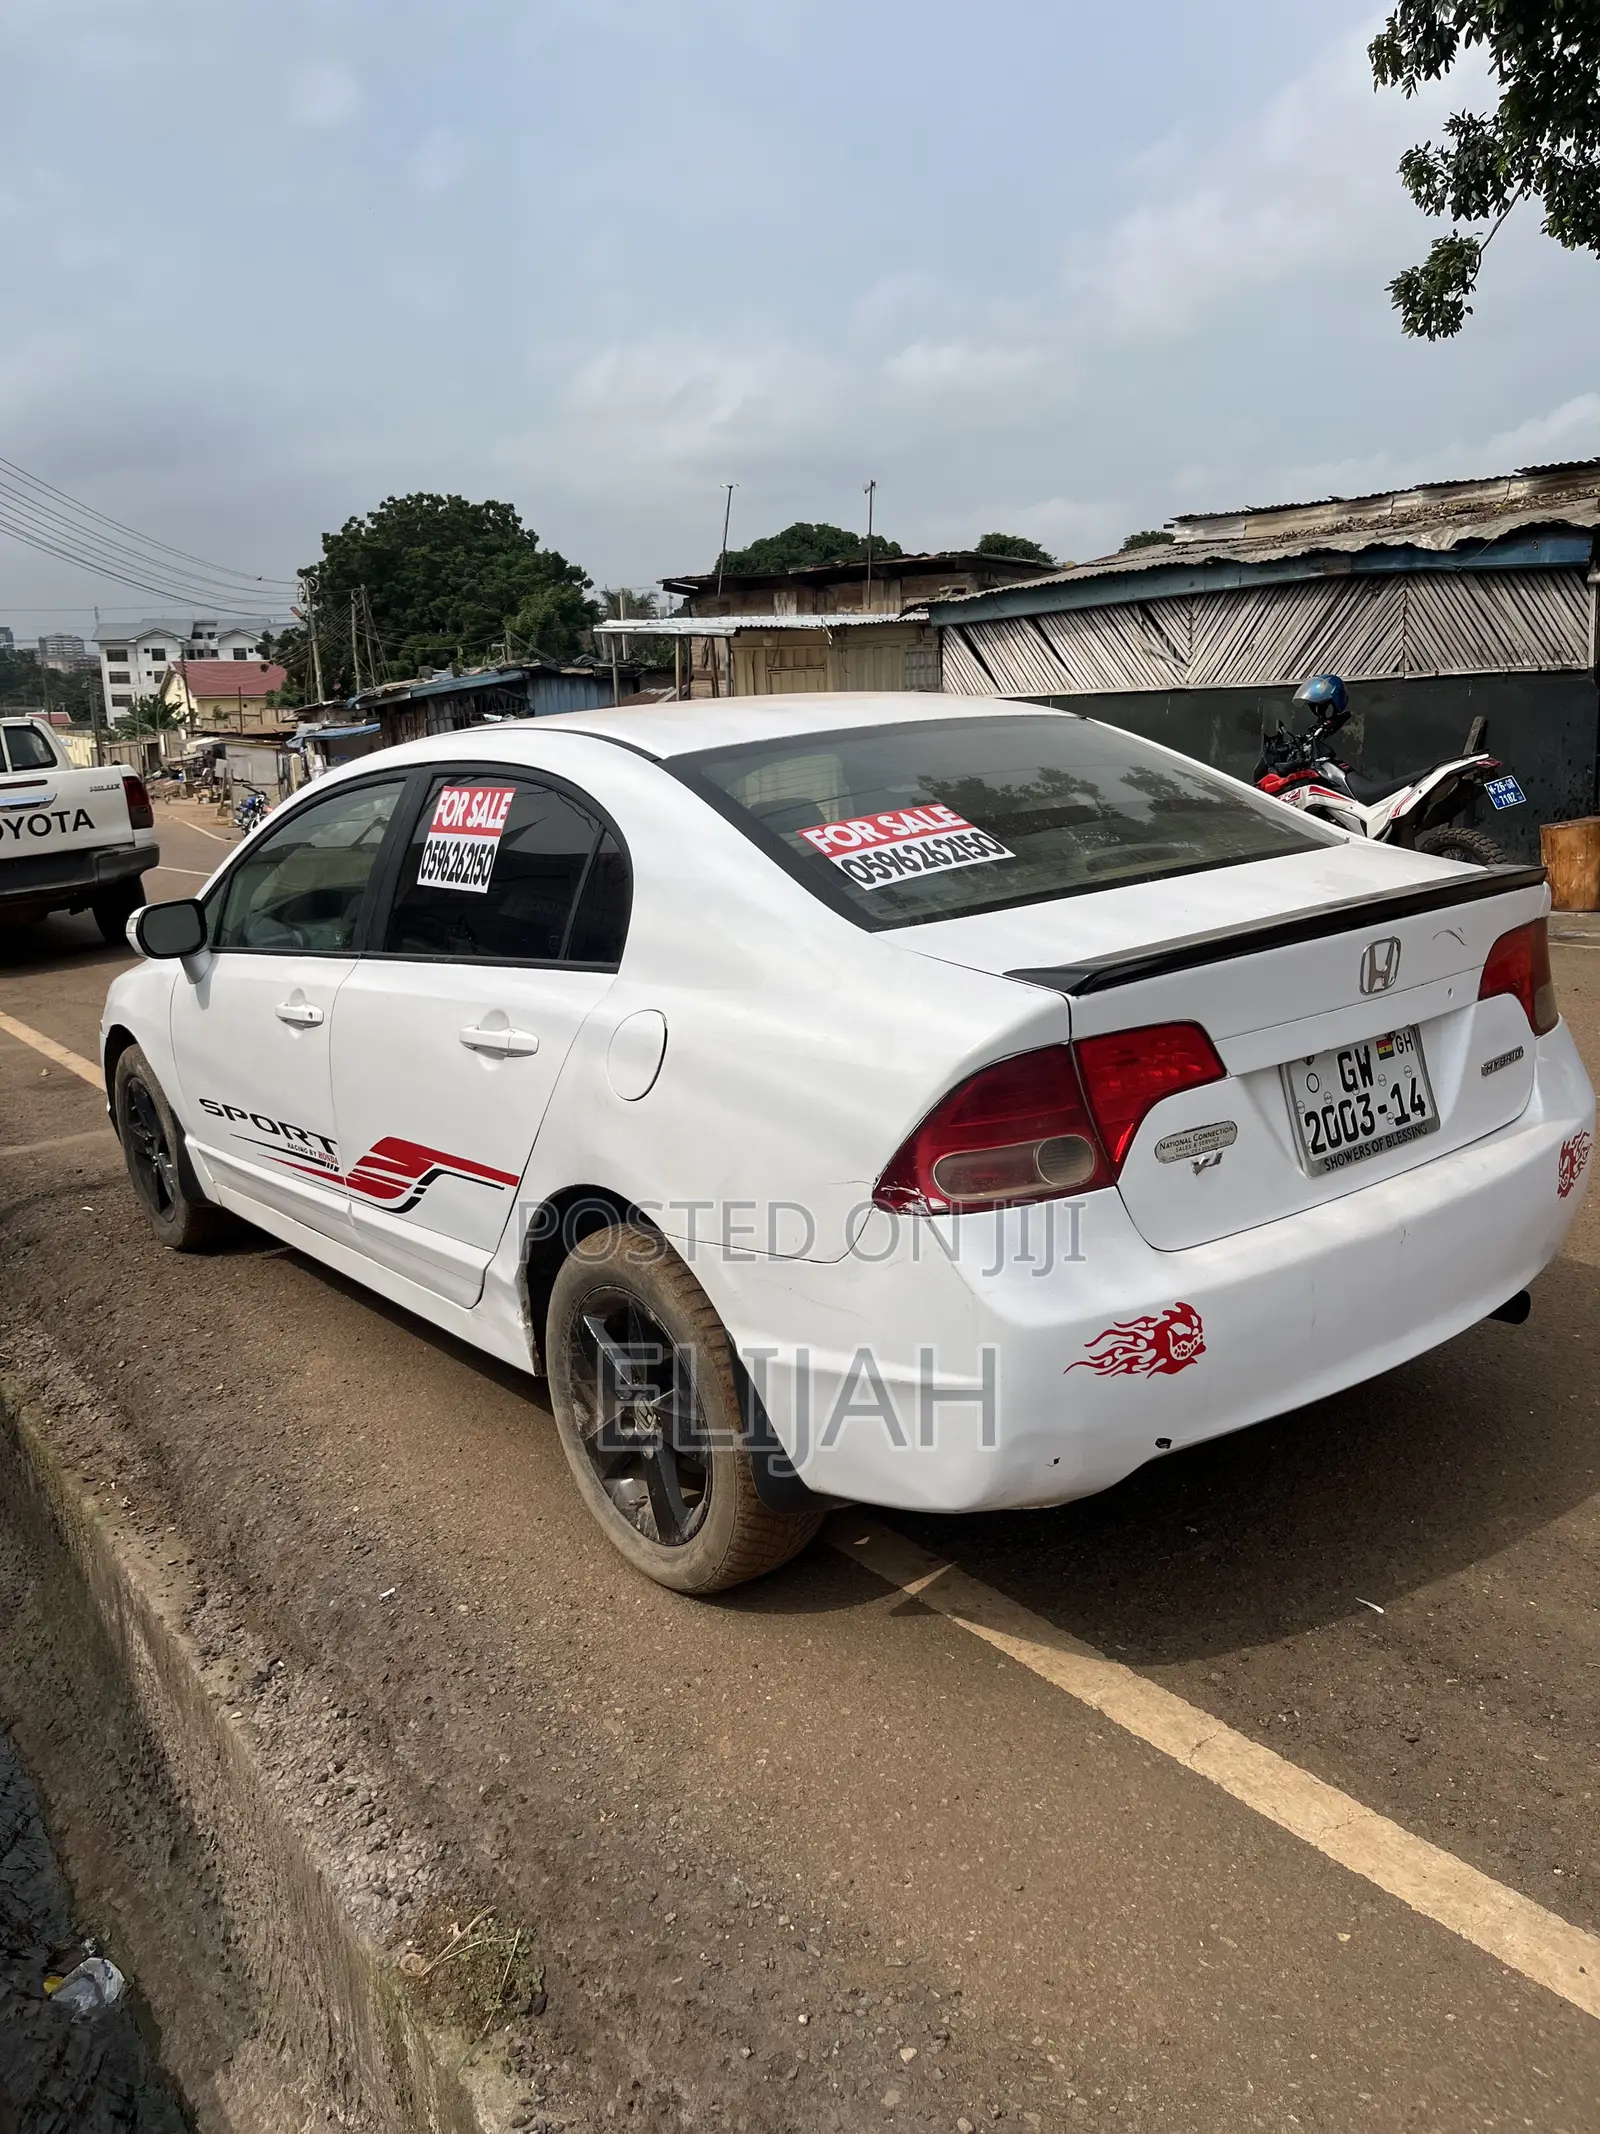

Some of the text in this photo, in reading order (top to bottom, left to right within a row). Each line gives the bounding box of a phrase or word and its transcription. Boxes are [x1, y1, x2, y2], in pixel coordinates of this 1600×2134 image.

[0, 808, 95, 840] YOTA
[432, 791, 514, 829] FOR SALE
[802, 806, 968, 854] FOR SALE
[420, 840, 495, 886] 0596262150
[840, 832, 1005, 884] 0596262150
[1395, 1032, 1414, 1054] GH
[1337, 1045, 1374, 1093] GW
[199, 1098, 338, 1156] SPORT
[1304, 1077, 1426, 1155] 2003-14
[287, 1142, 339, 1165] RACING BY HONDA
[1175, 1143, 1191, 1152] SALES
[1199, 1136, 1220, 1147] SERVICE
[1325, 1123, 1428, 1171] SHOWERS OF BLESSING
